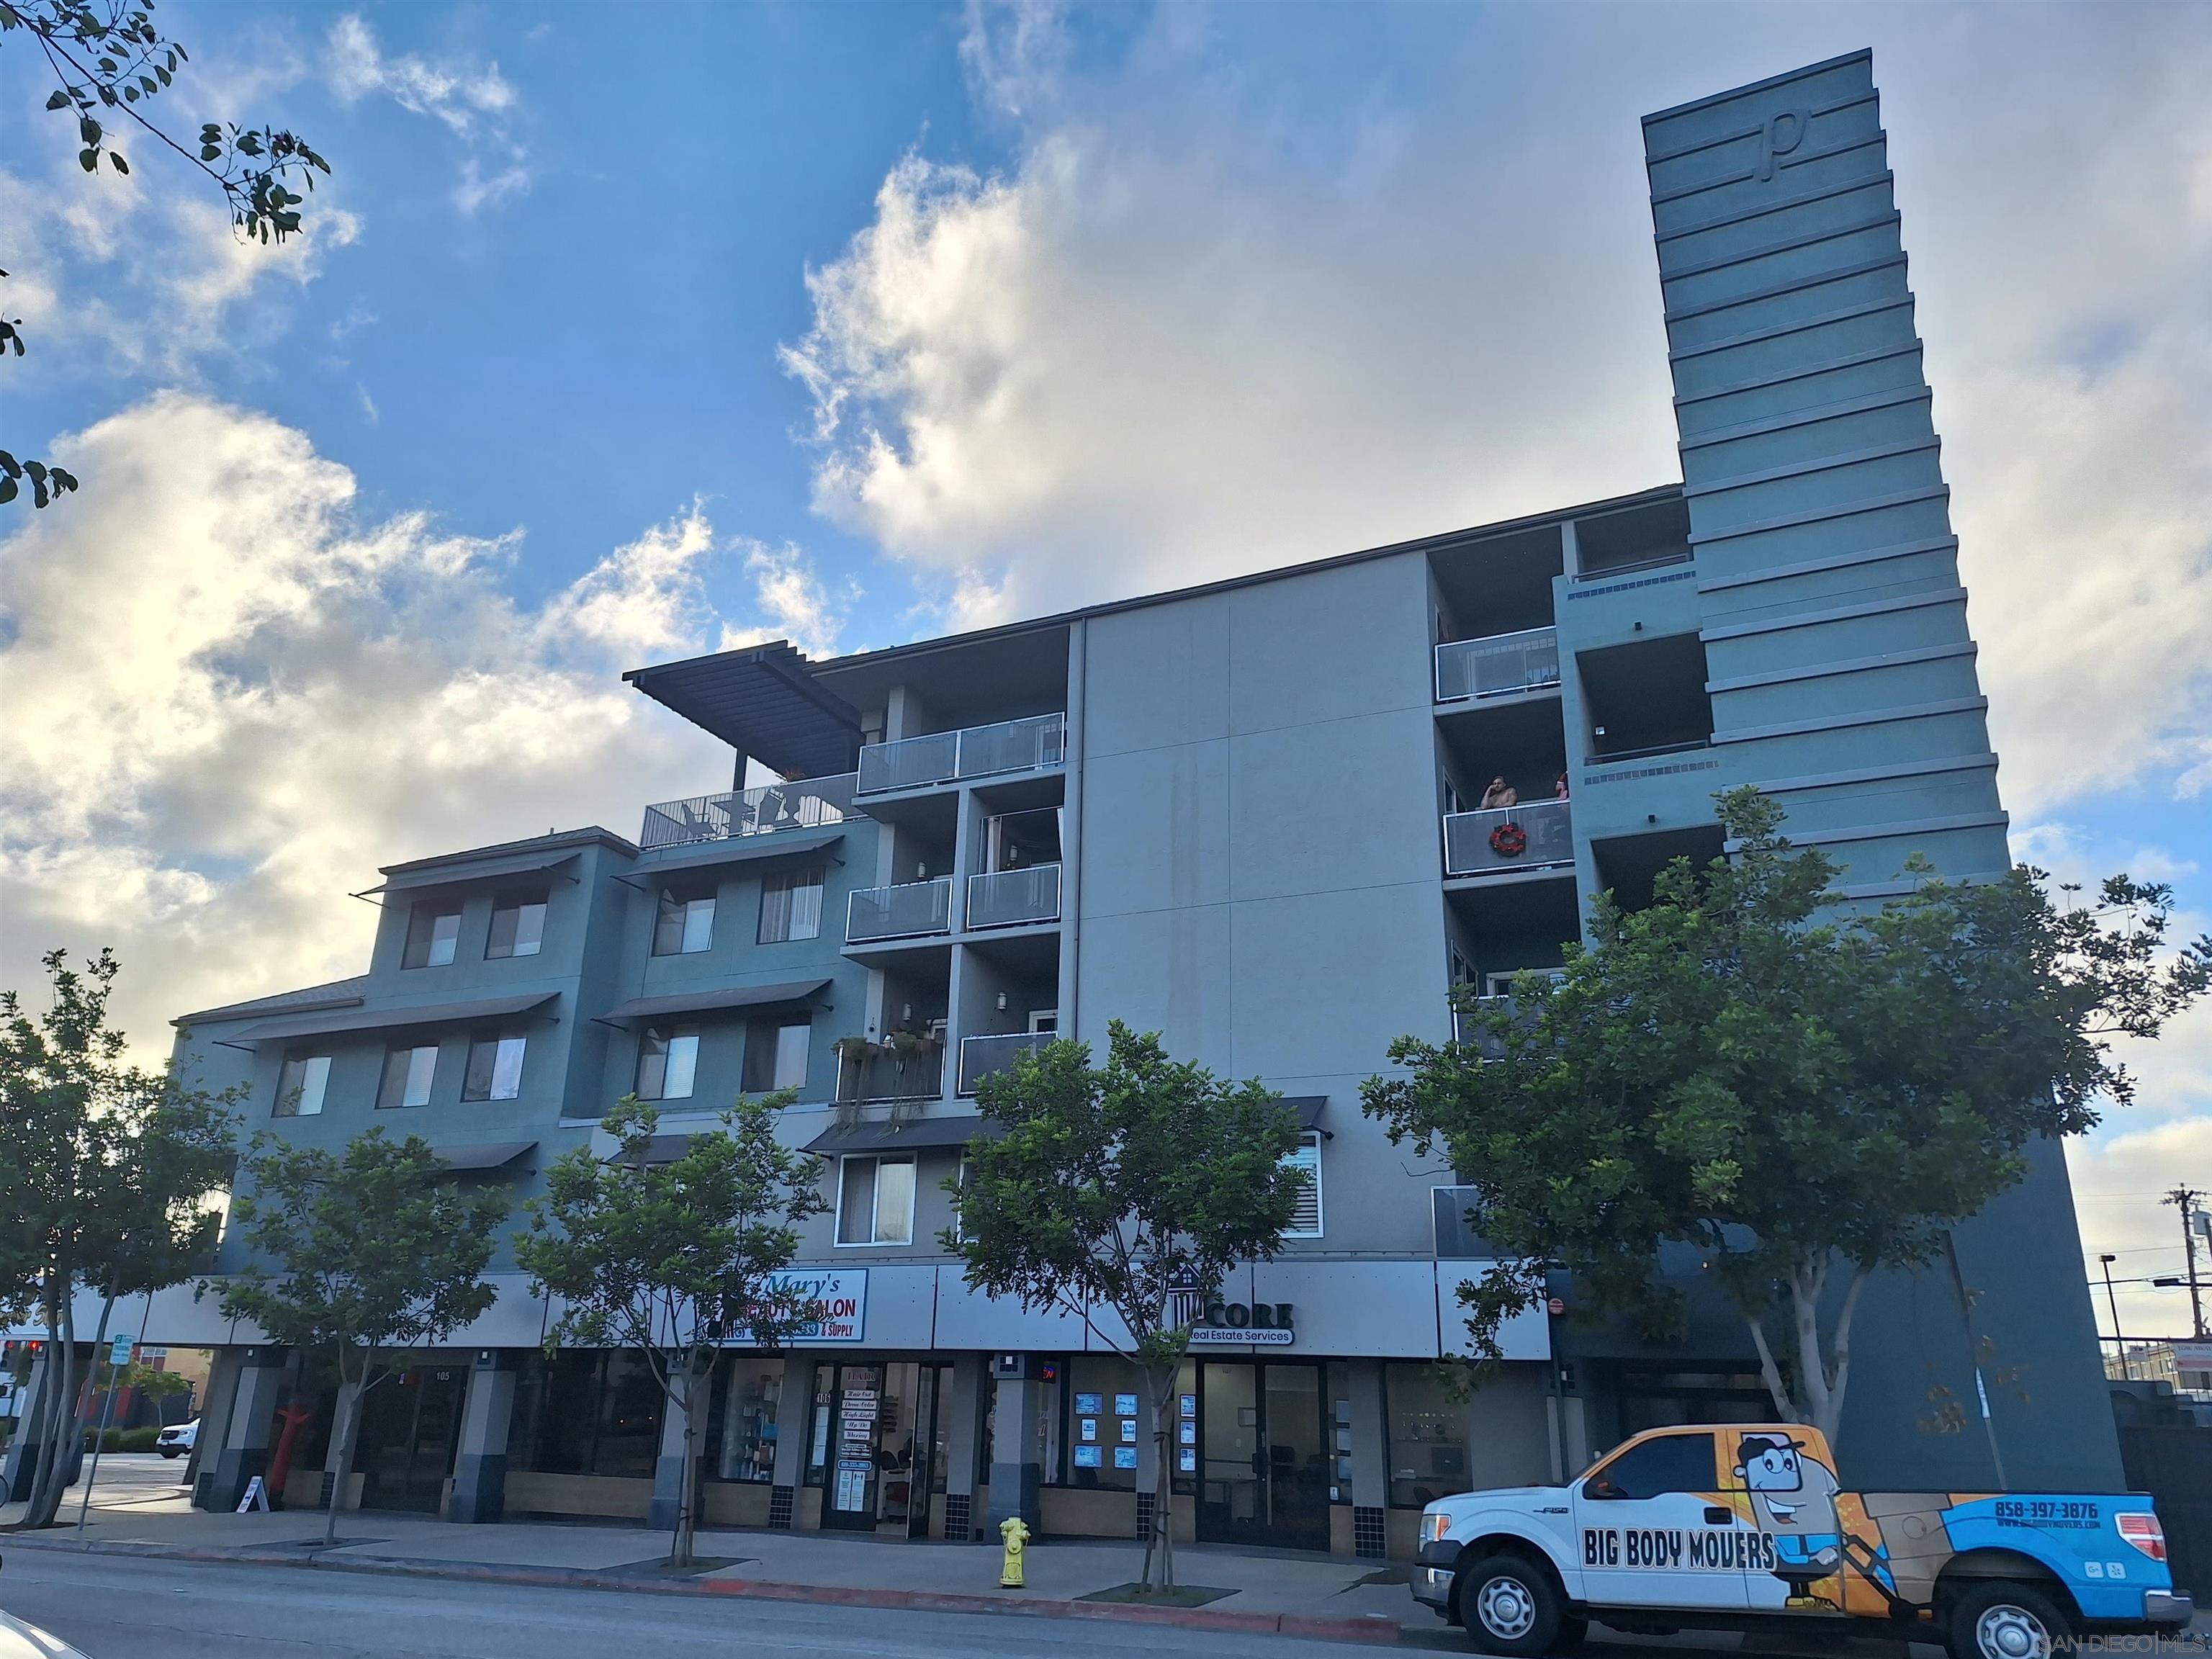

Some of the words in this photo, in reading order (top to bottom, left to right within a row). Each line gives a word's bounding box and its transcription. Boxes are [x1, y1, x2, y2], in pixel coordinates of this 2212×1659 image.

[764, 1273, 840, 1299] Mary's
[1205, 1303, 1294, 1328] CORE
[828, 1323, 853, 1337] SUPPLY
[1211, 1330, 1243, 1341] Estate
[1245, 1331, 1289, 1341] Services
[436, 1371, 450, 1381] 105
[818, 1393, 830, 1403] 106
[1995, 1501, 2099, 1519] 858-397-3876
[1583, 1529, 1619, 1566] BIG
[1625, 1529, 1682, 1568] BODY
[1688, 1531, 1776, 1570] MOVERS
